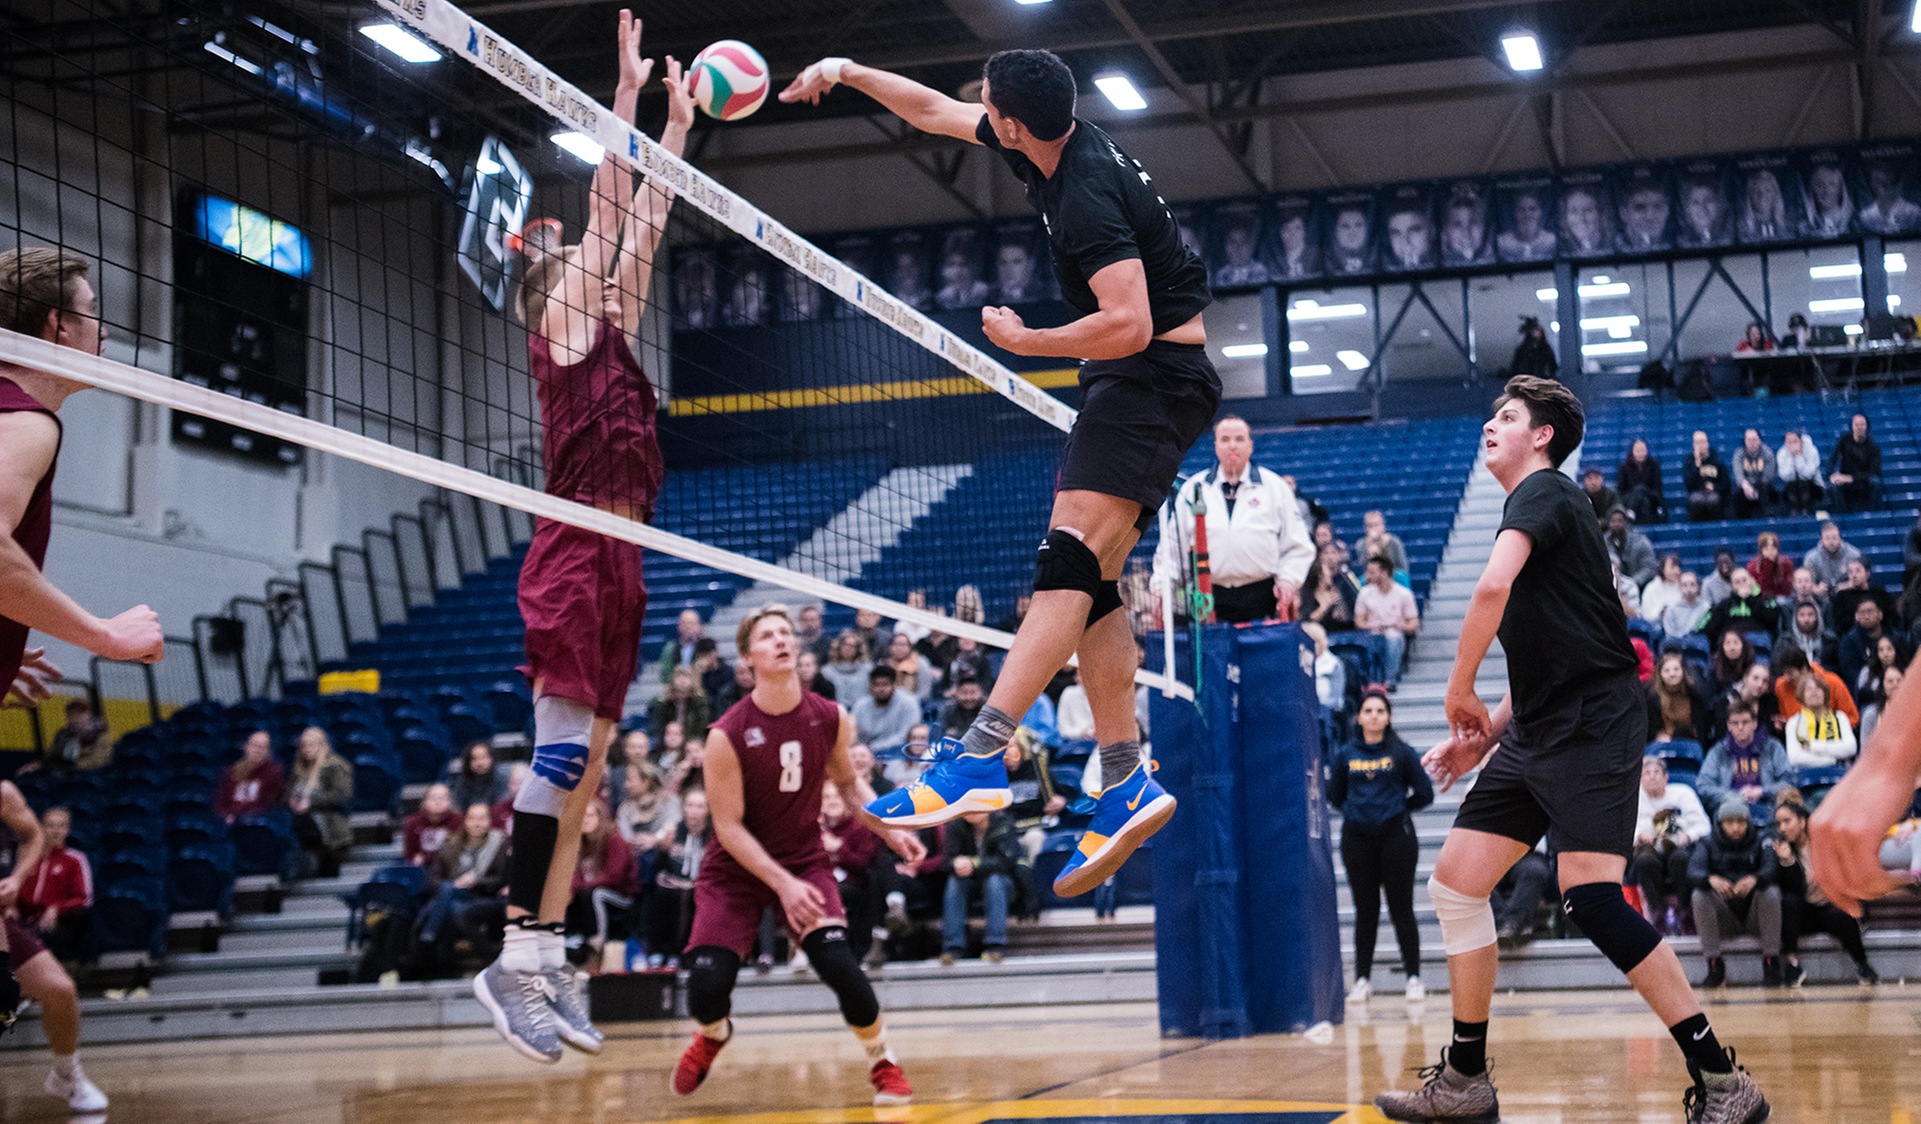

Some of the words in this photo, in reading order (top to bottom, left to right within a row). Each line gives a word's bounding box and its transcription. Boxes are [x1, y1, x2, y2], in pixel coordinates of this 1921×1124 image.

[483, 35, 542, 99] HUMBER
[545, 77, 597, 133] HAWKS
[779, 740, 802, 792] 8
